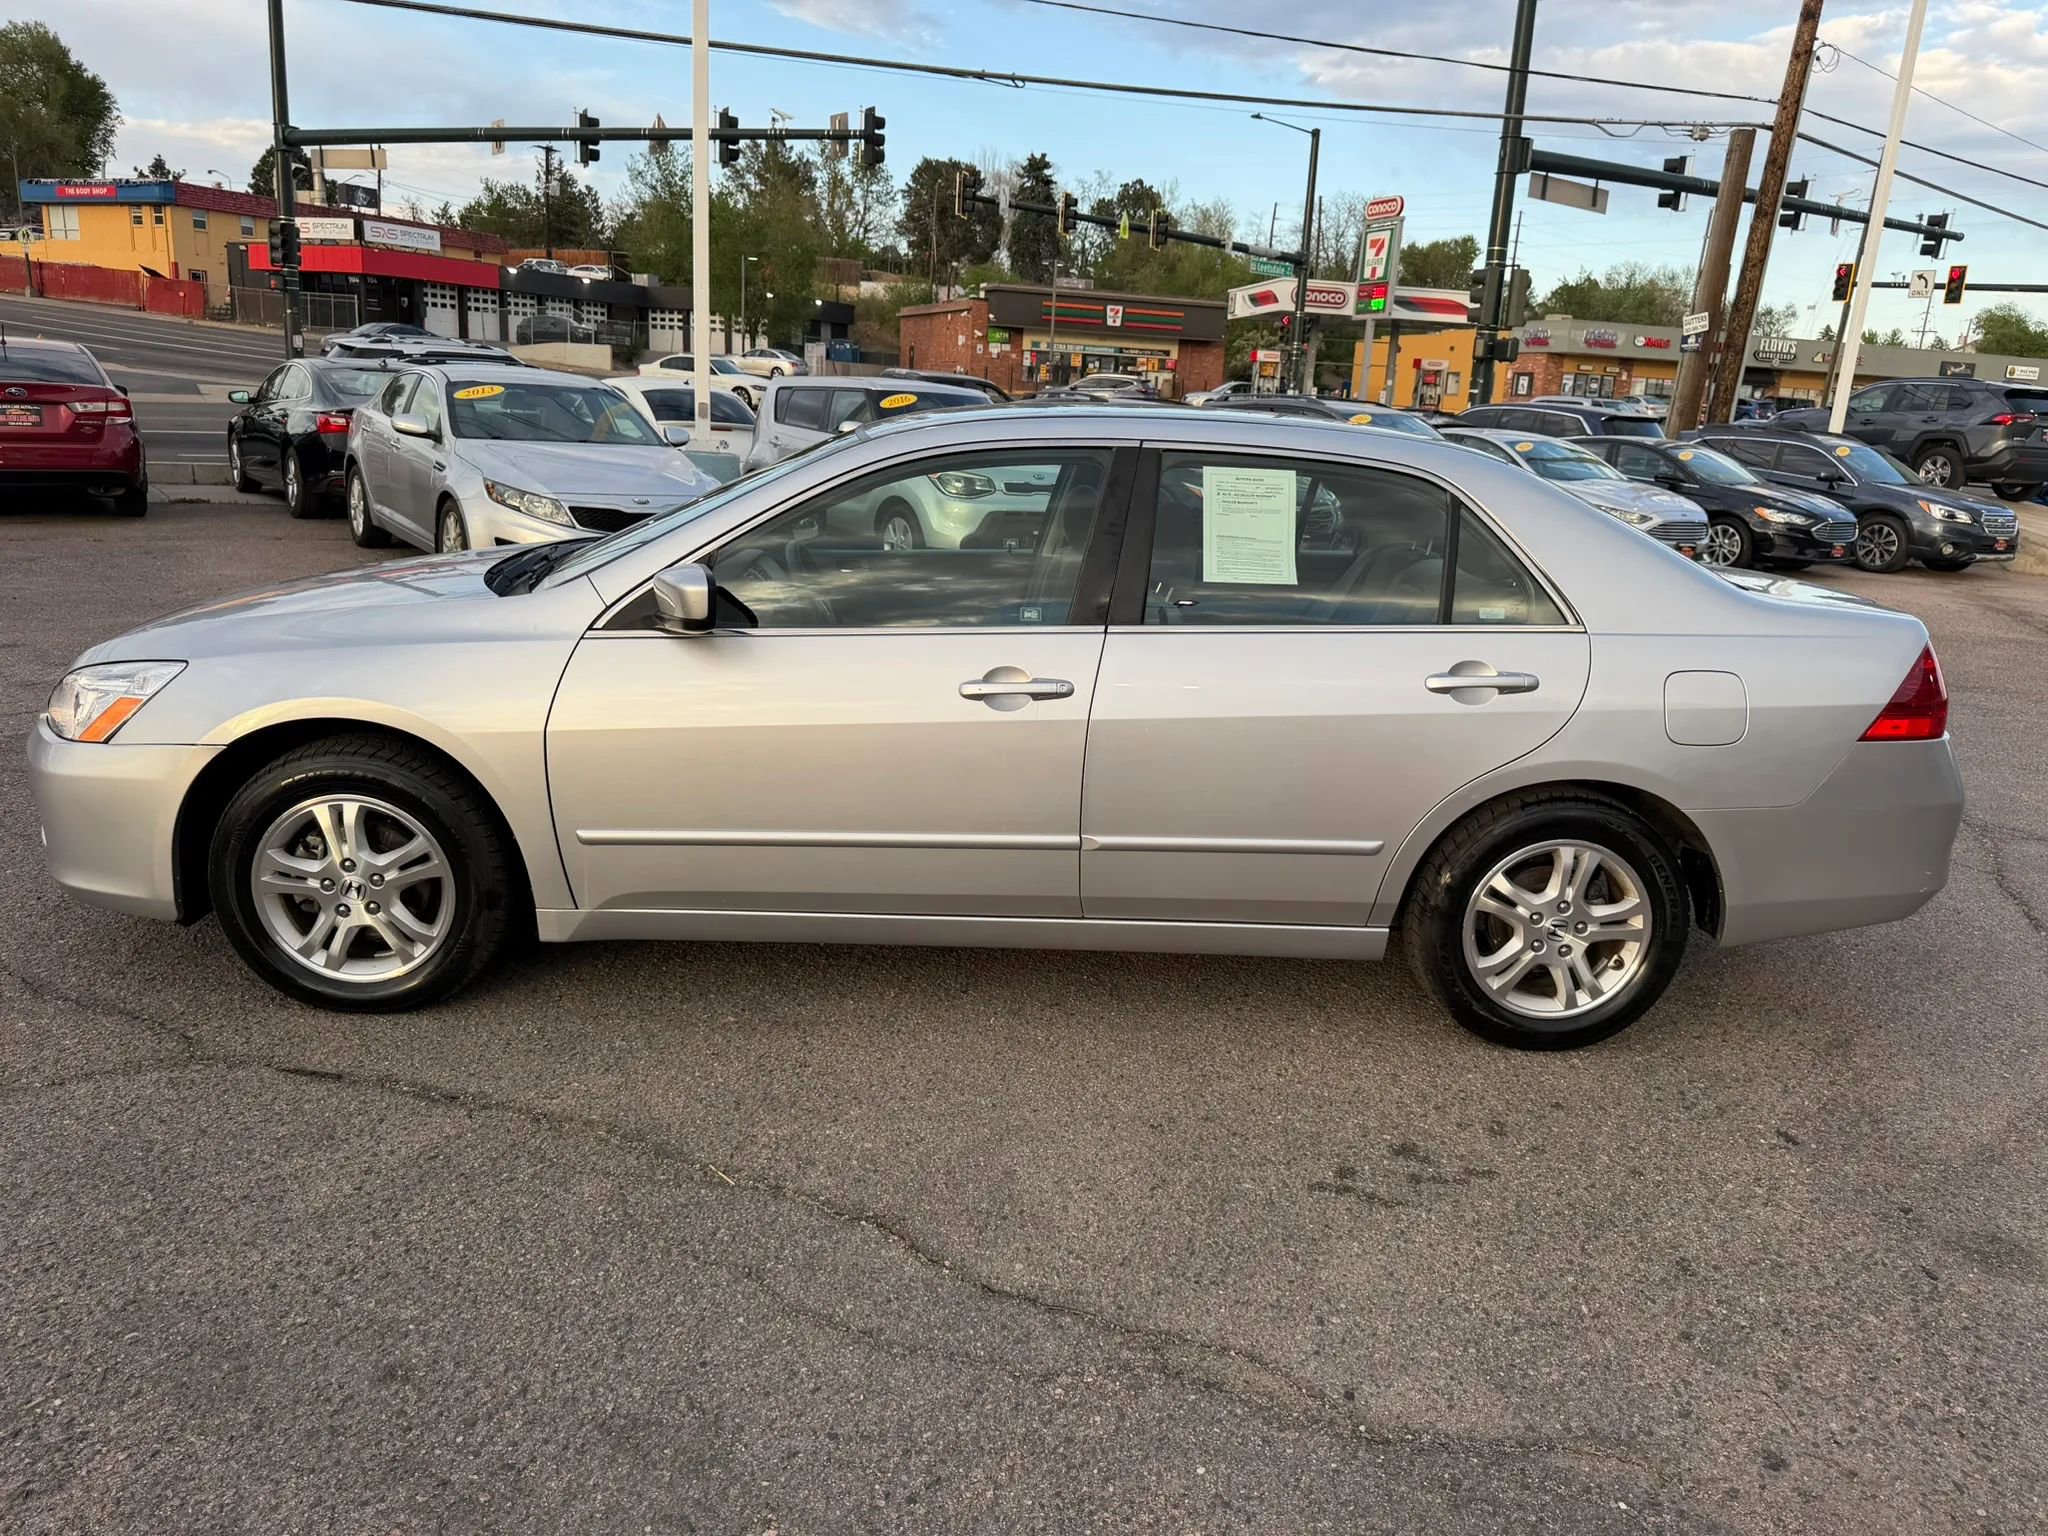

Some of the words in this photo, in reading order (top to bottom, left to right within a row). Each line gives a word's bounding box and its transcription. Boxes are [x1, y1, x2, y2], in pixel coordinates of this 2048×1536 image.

[64, 187, 75, 195] THE
[76, 187, 91, 195] BODY
[92, 187, 108, 195] SHOP
[312, 222, 348, 230] SPECTRUM
[399, 229, 435, 241] SPECTRUM
[1304, 291, 1345, 303] onoco
[1684, 315, 1708, 326] GUTTERS
[1760, 338, 1798, 353] FLOYD'S
[464, 387, 495, 398] 2013
